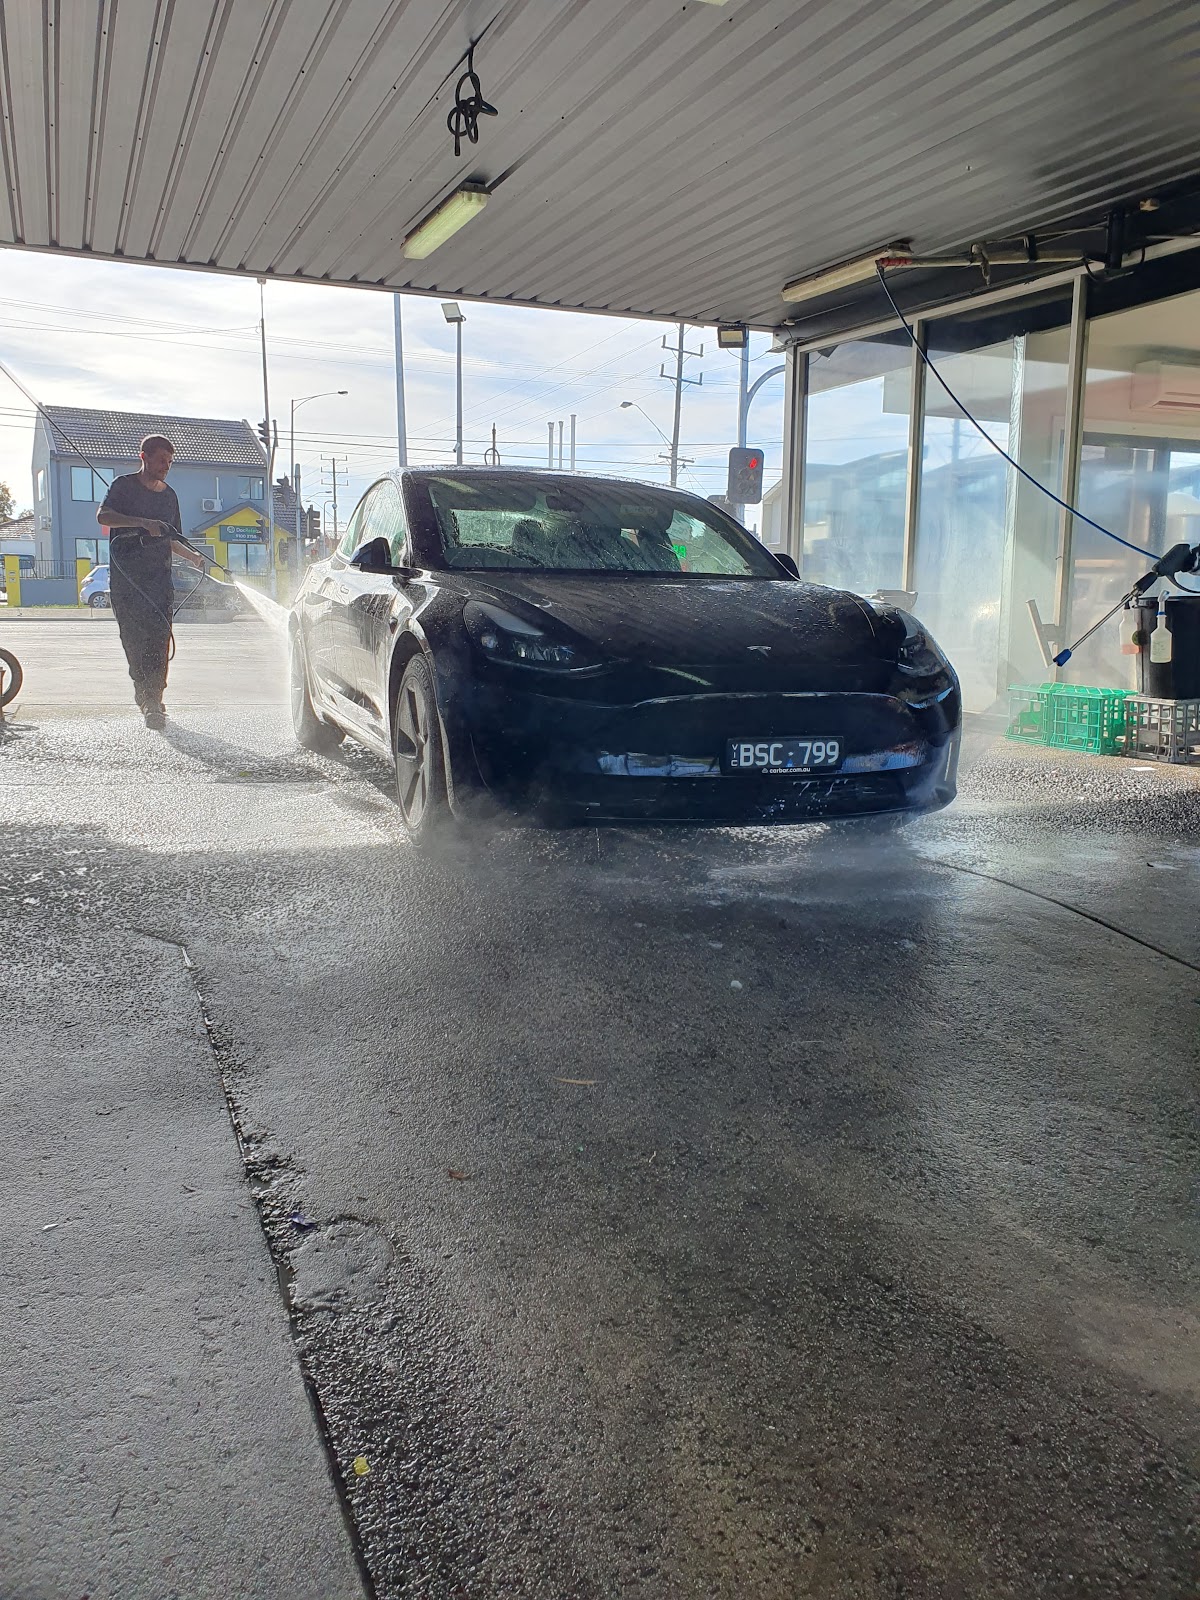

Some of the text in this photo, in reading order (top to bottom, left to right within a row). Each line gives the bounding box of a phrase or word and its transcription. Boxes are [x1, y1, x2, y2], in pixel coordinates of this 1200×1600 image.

[730, 744, 738, 767] VIC
[739, 741, 840, 767] BSC 799
[769, 766, 811, 774] carbar.com.au
